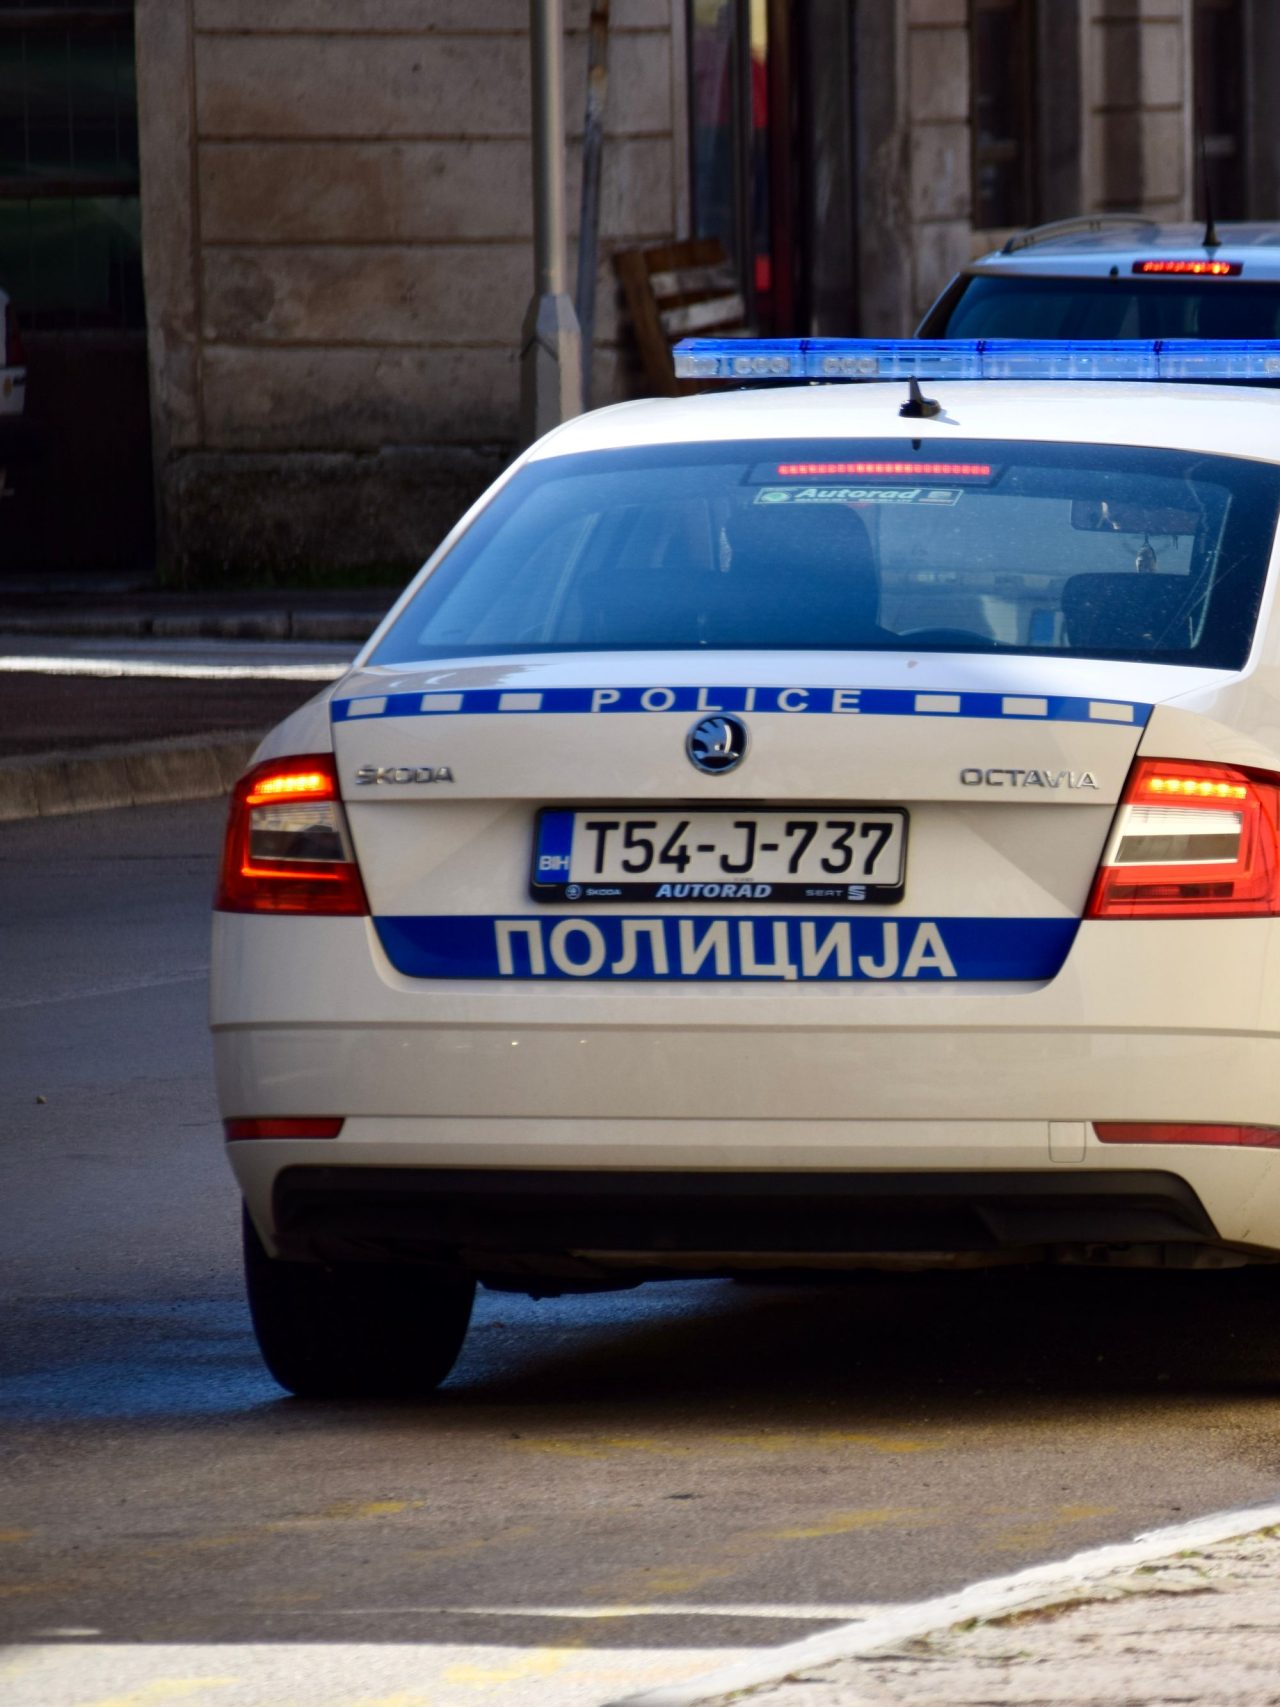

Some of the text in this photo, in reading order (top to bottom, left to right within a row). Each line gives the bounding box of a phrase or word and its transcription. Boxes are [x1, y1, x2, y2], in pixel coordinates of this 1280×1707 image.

[795, 488, 922, 499] Autorad
[591, 688, 862, 713] POLICE
[355, 765, 456, 785] ŠKODA
[960, 768, 1100, 790] OCTAVIA
[585, 820, 894, 875] T54-J-737
[538, 855, 570, 871] BIH
[655, 883, 772, 898] AUTORAD
[805, 889, 843, 897] SEAT
[495, 918, 957, 980] ПОЛИЦИЈА
